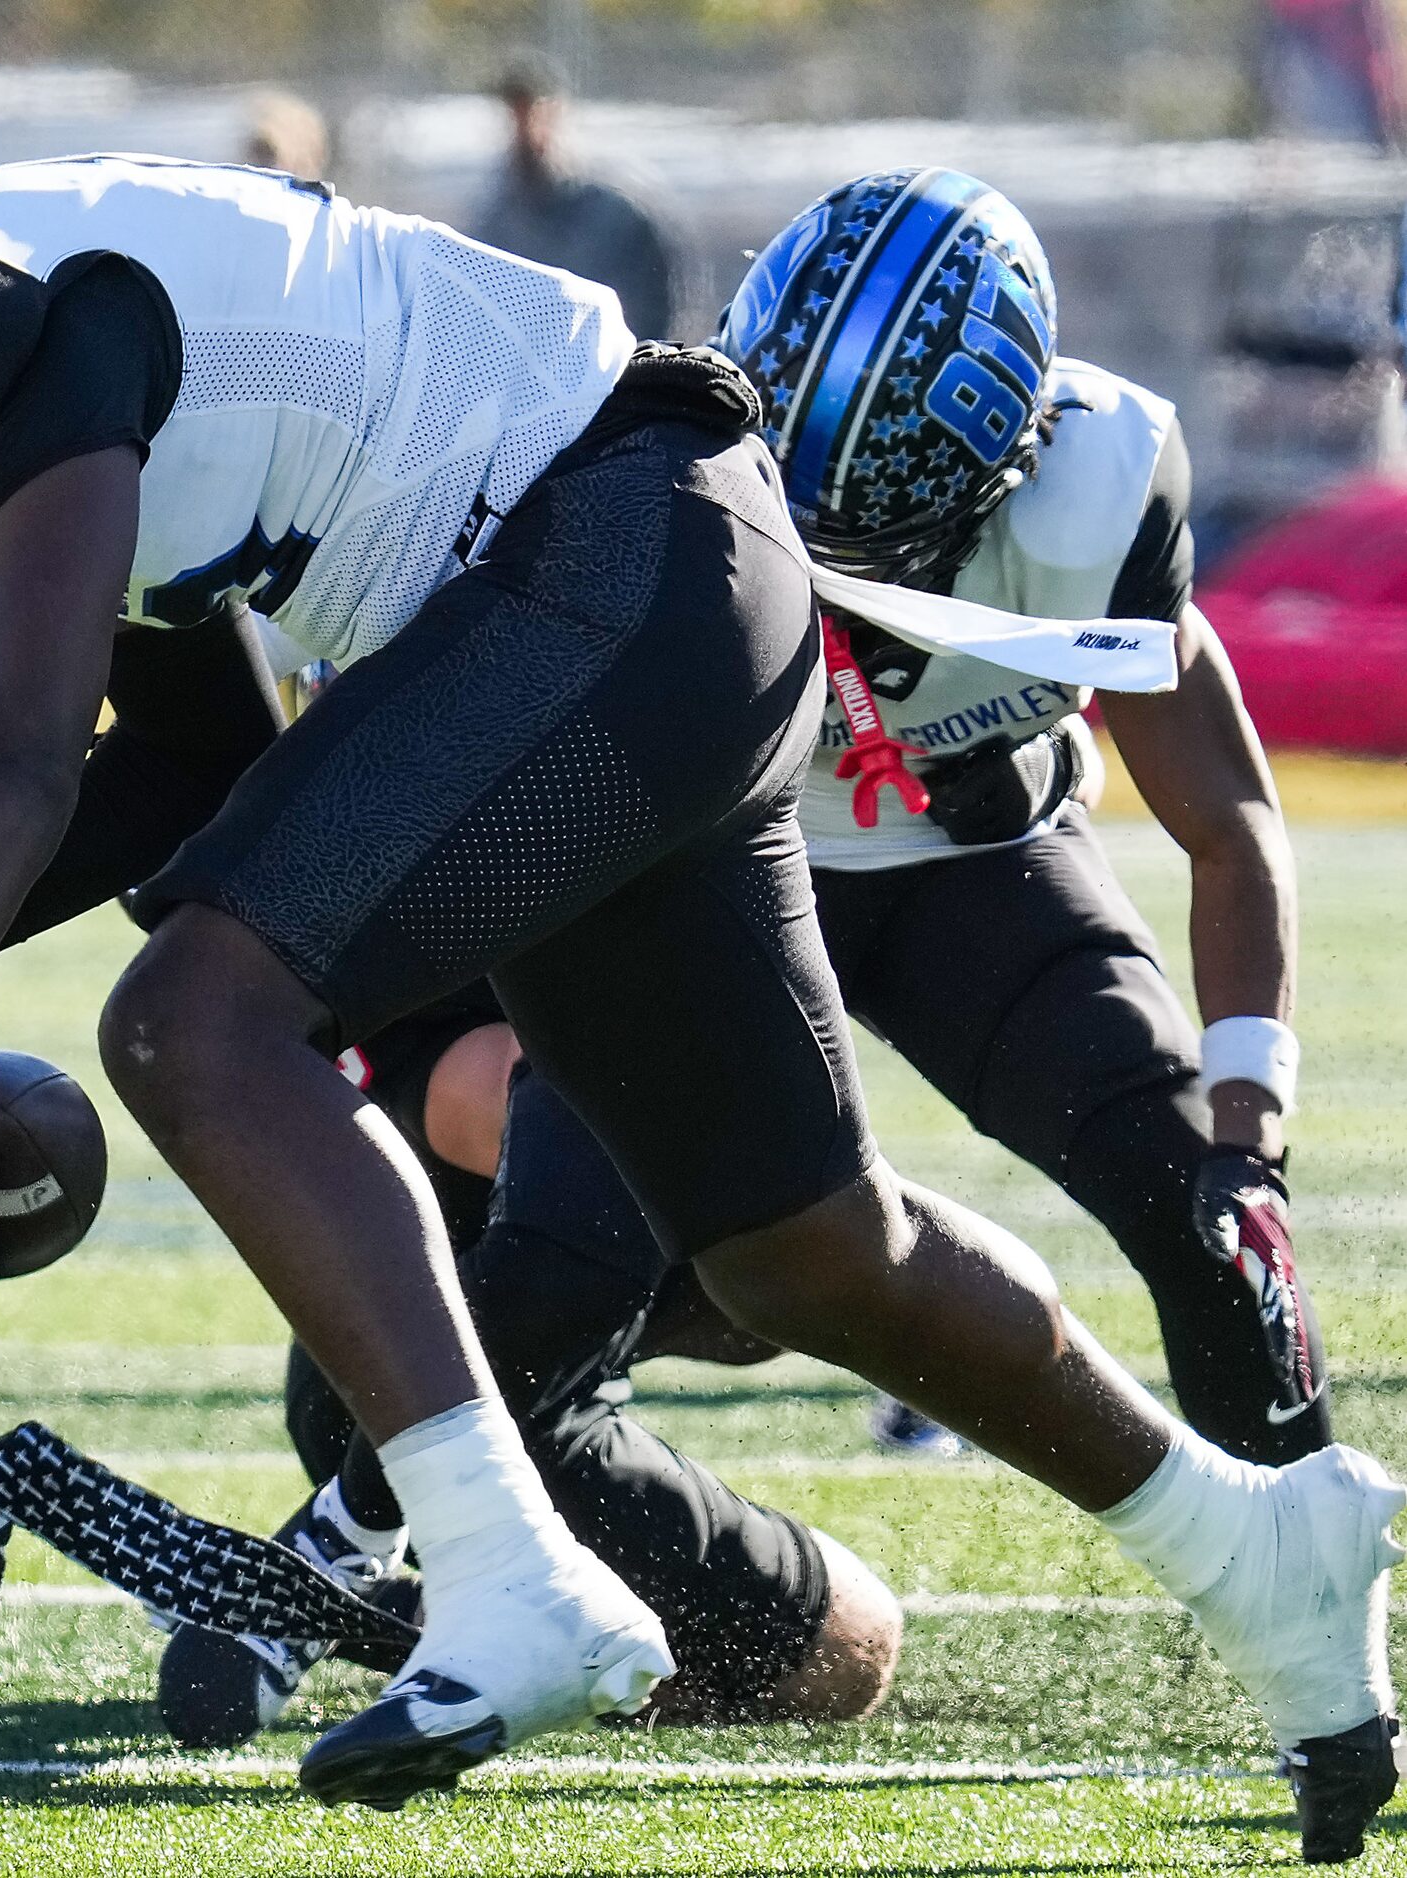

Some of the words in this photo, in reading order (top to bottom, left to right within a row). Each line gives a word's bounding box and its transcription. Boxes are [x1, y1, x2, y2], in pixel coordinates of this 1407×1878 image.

[923, 248, 1054, 466] 817
[833, 667, 879, 733] NXTRND
[898, 680, 1073, 748] CROWLEY
